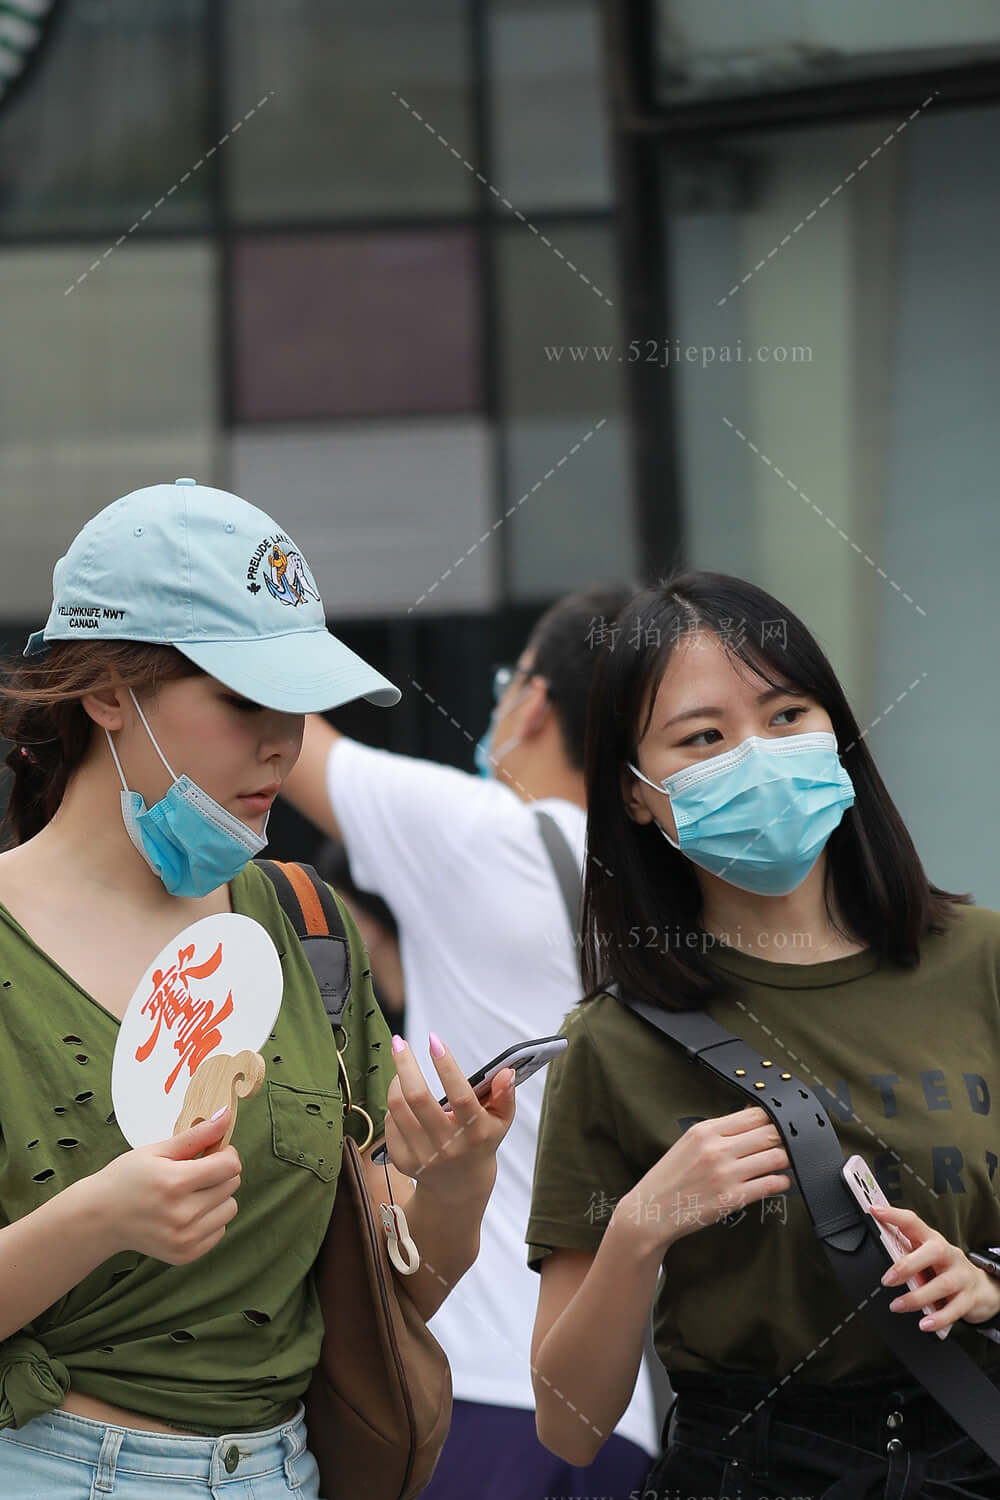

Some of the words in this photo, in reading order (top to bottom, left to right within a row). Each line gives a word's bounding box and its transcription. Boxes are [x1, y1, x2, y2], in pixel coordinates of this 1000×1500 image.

[247, 539, 272, 580] PRELUDE
[103, 608, 126, 620] NWT
[69, 618, 99, 629] CANADA
